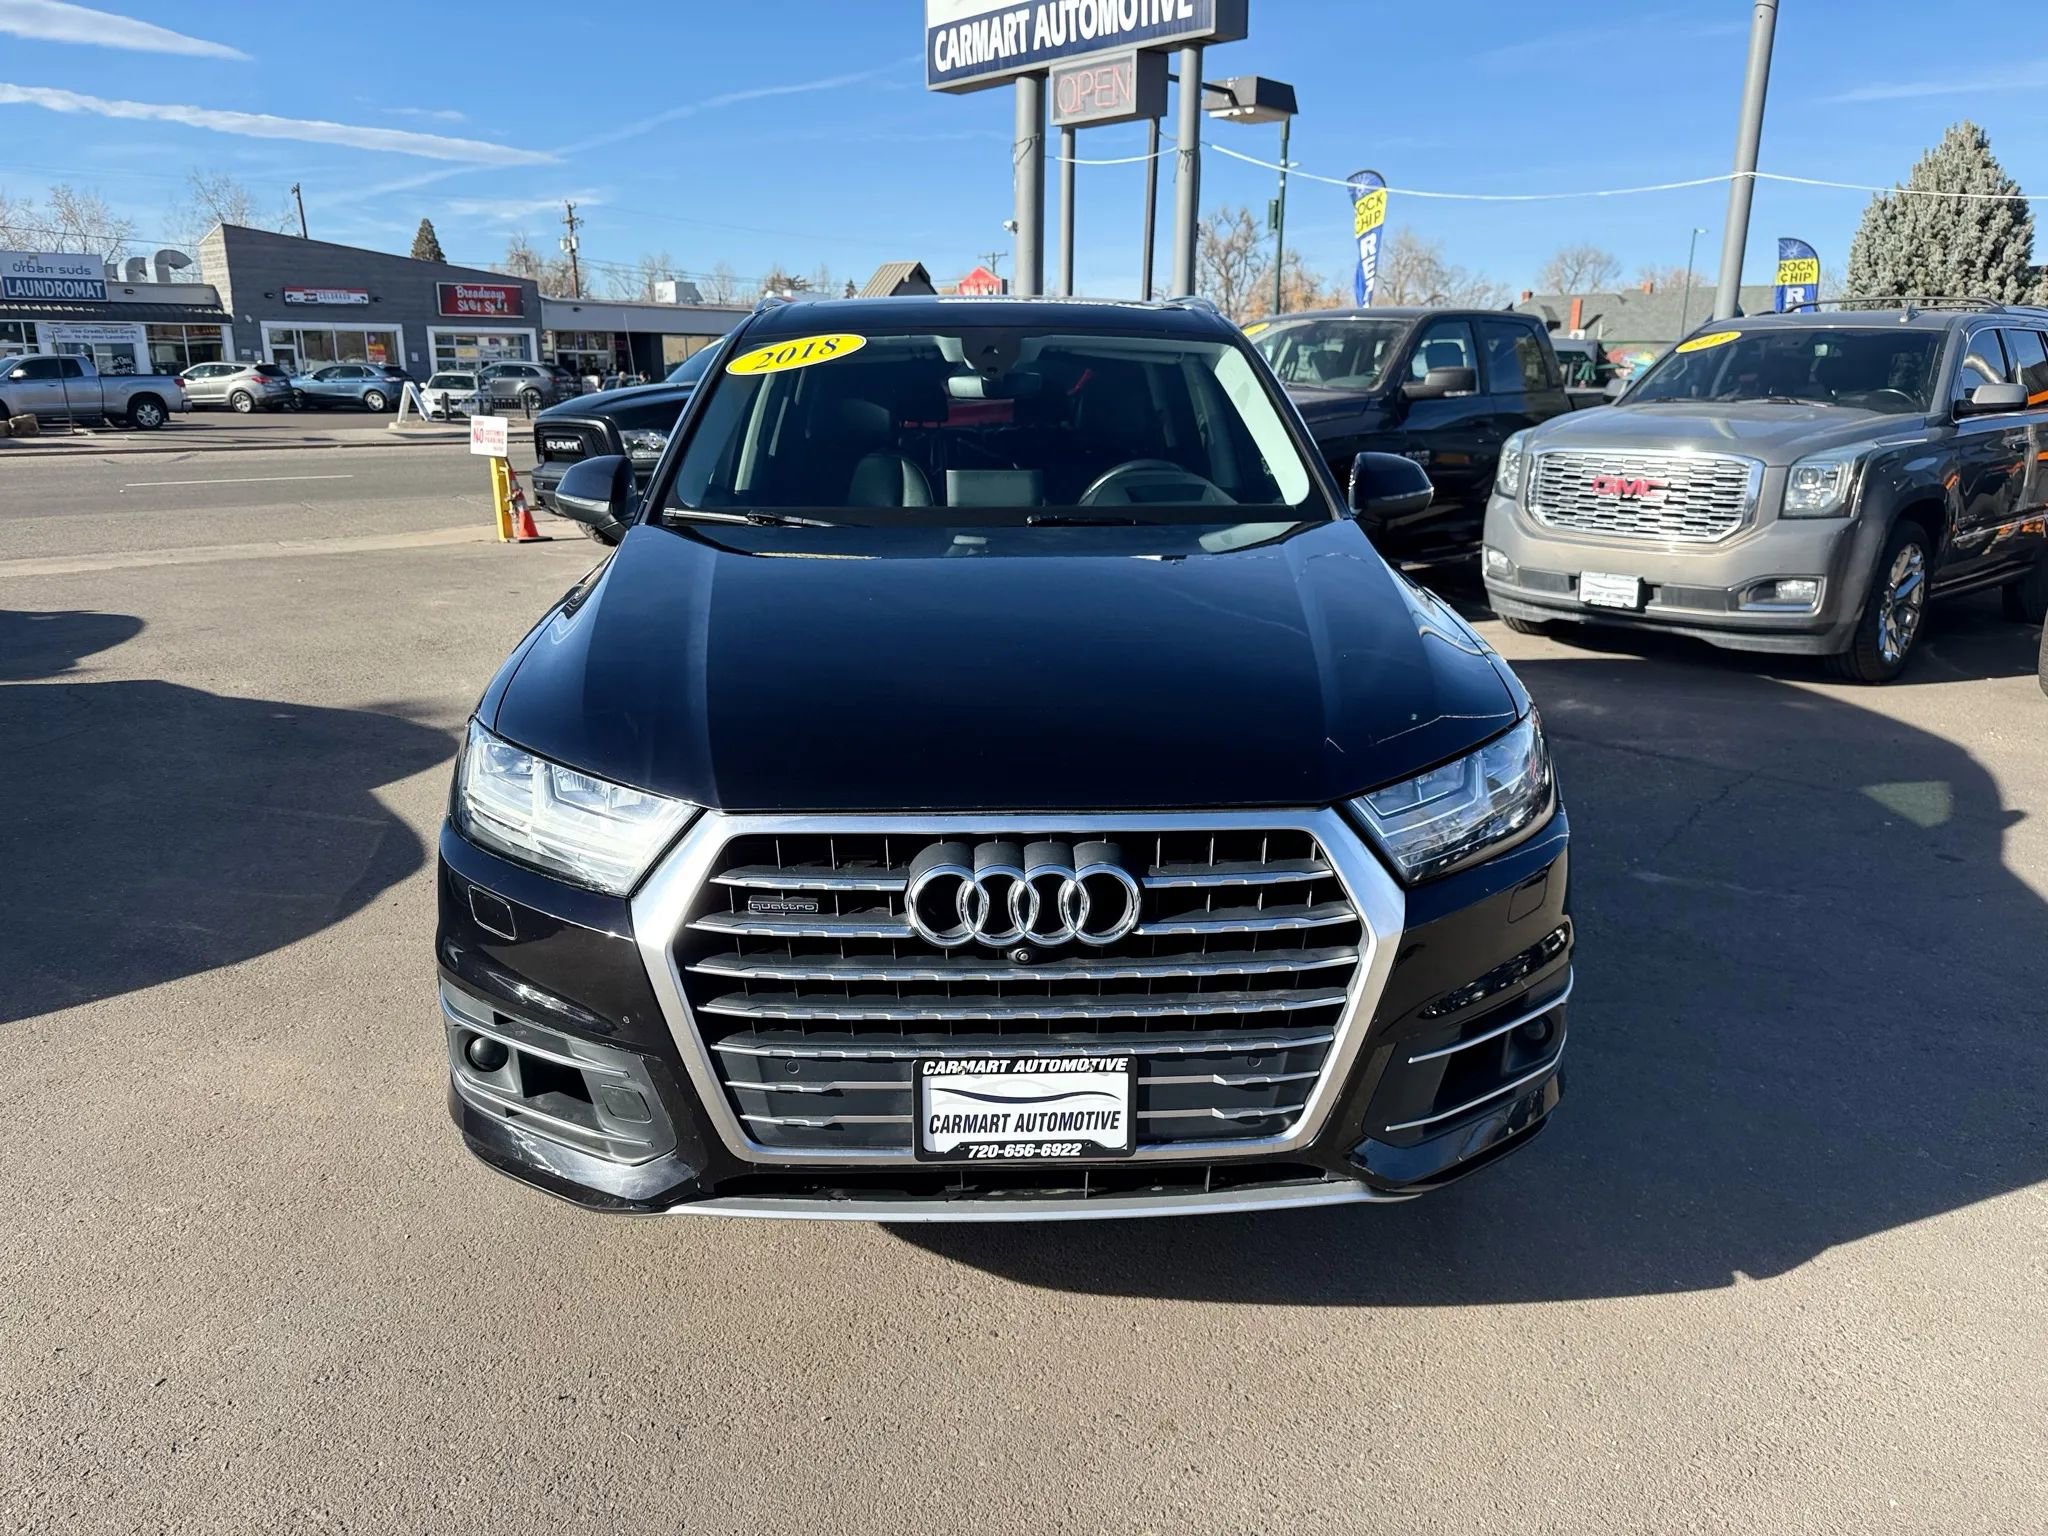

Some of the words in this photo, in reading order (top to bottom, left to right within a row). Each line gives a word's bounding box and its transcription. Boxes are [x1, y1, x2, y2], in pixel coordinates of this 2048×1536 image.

[934, 9, 1030, 73] CARMART
[1057, 64, 1133, 113] OPEN
[1356, 193, 1383, 217] OCK
[12, 261, 54, 274] urban
[58, 265, 92, 276] suds
[1779, 260, 1815, 273] ROCK
[1780, 272, 1812, 284] CHIP
[6, 279, 103, 299] LAUNDROMAT
[752, 337, 841, 370] 2018
[473, 426, 485, 444] NO
[546, 440, 581, 450] RAM
[751, 903, 815, 911] quattro
[922, 1059, 1010, 1075] CARMART
[1012, 1057, 1129, 1073] AUTOMOTIVE
[929, 1113, 1011, 1134] CARMART
[1013, 1110, 1121, 1132] AUTOMOTIVE
[967, 1142, 1083, 1159] 720-656-6922
